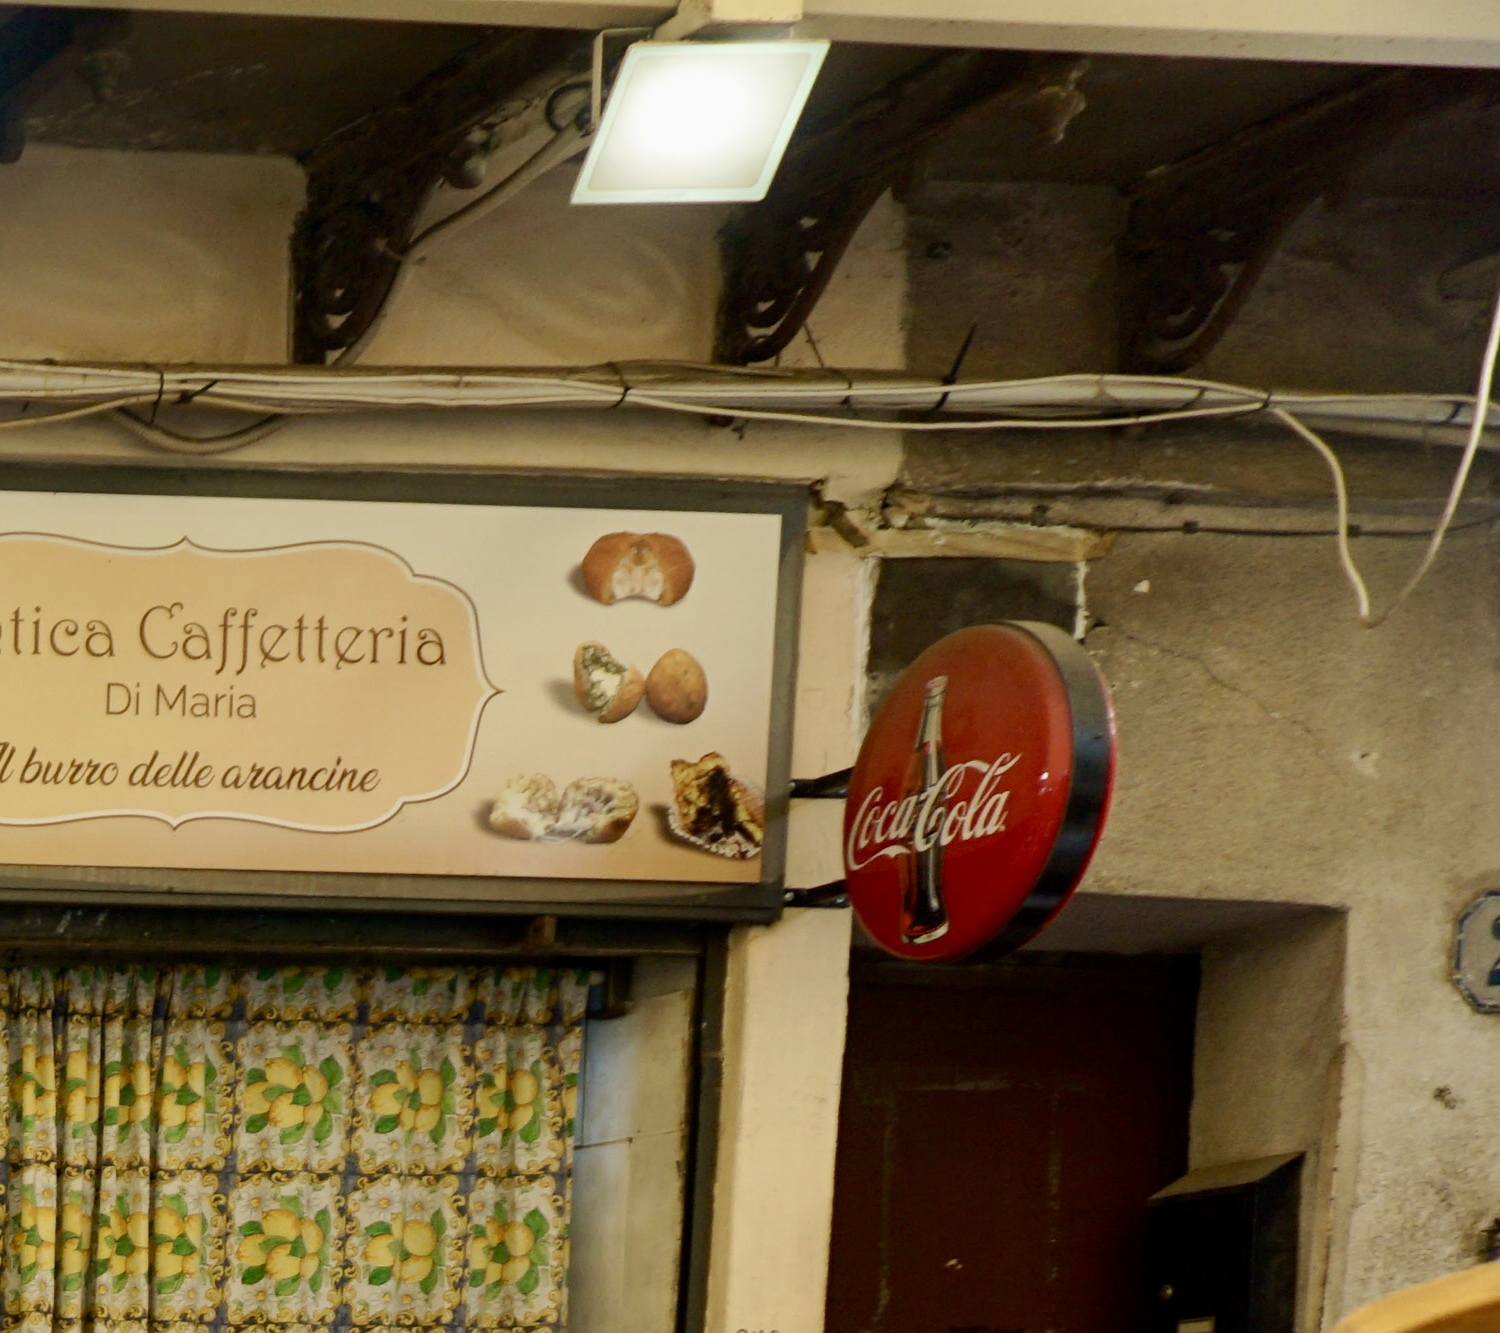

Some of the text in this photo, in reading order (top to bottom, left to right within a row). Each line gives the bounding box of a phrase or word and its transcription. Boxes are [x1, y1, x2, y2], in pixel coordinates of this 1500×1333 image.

[138, 602, 447, 676] Caffetteria
[105, 682, 258, 719] Di Maria
[19, 746, 119, 787] burro
[128, 750, 216, 789] delle
[215, 756, 381, 792] arancine
[846, 751, 1024, 872] Coca-Cola
